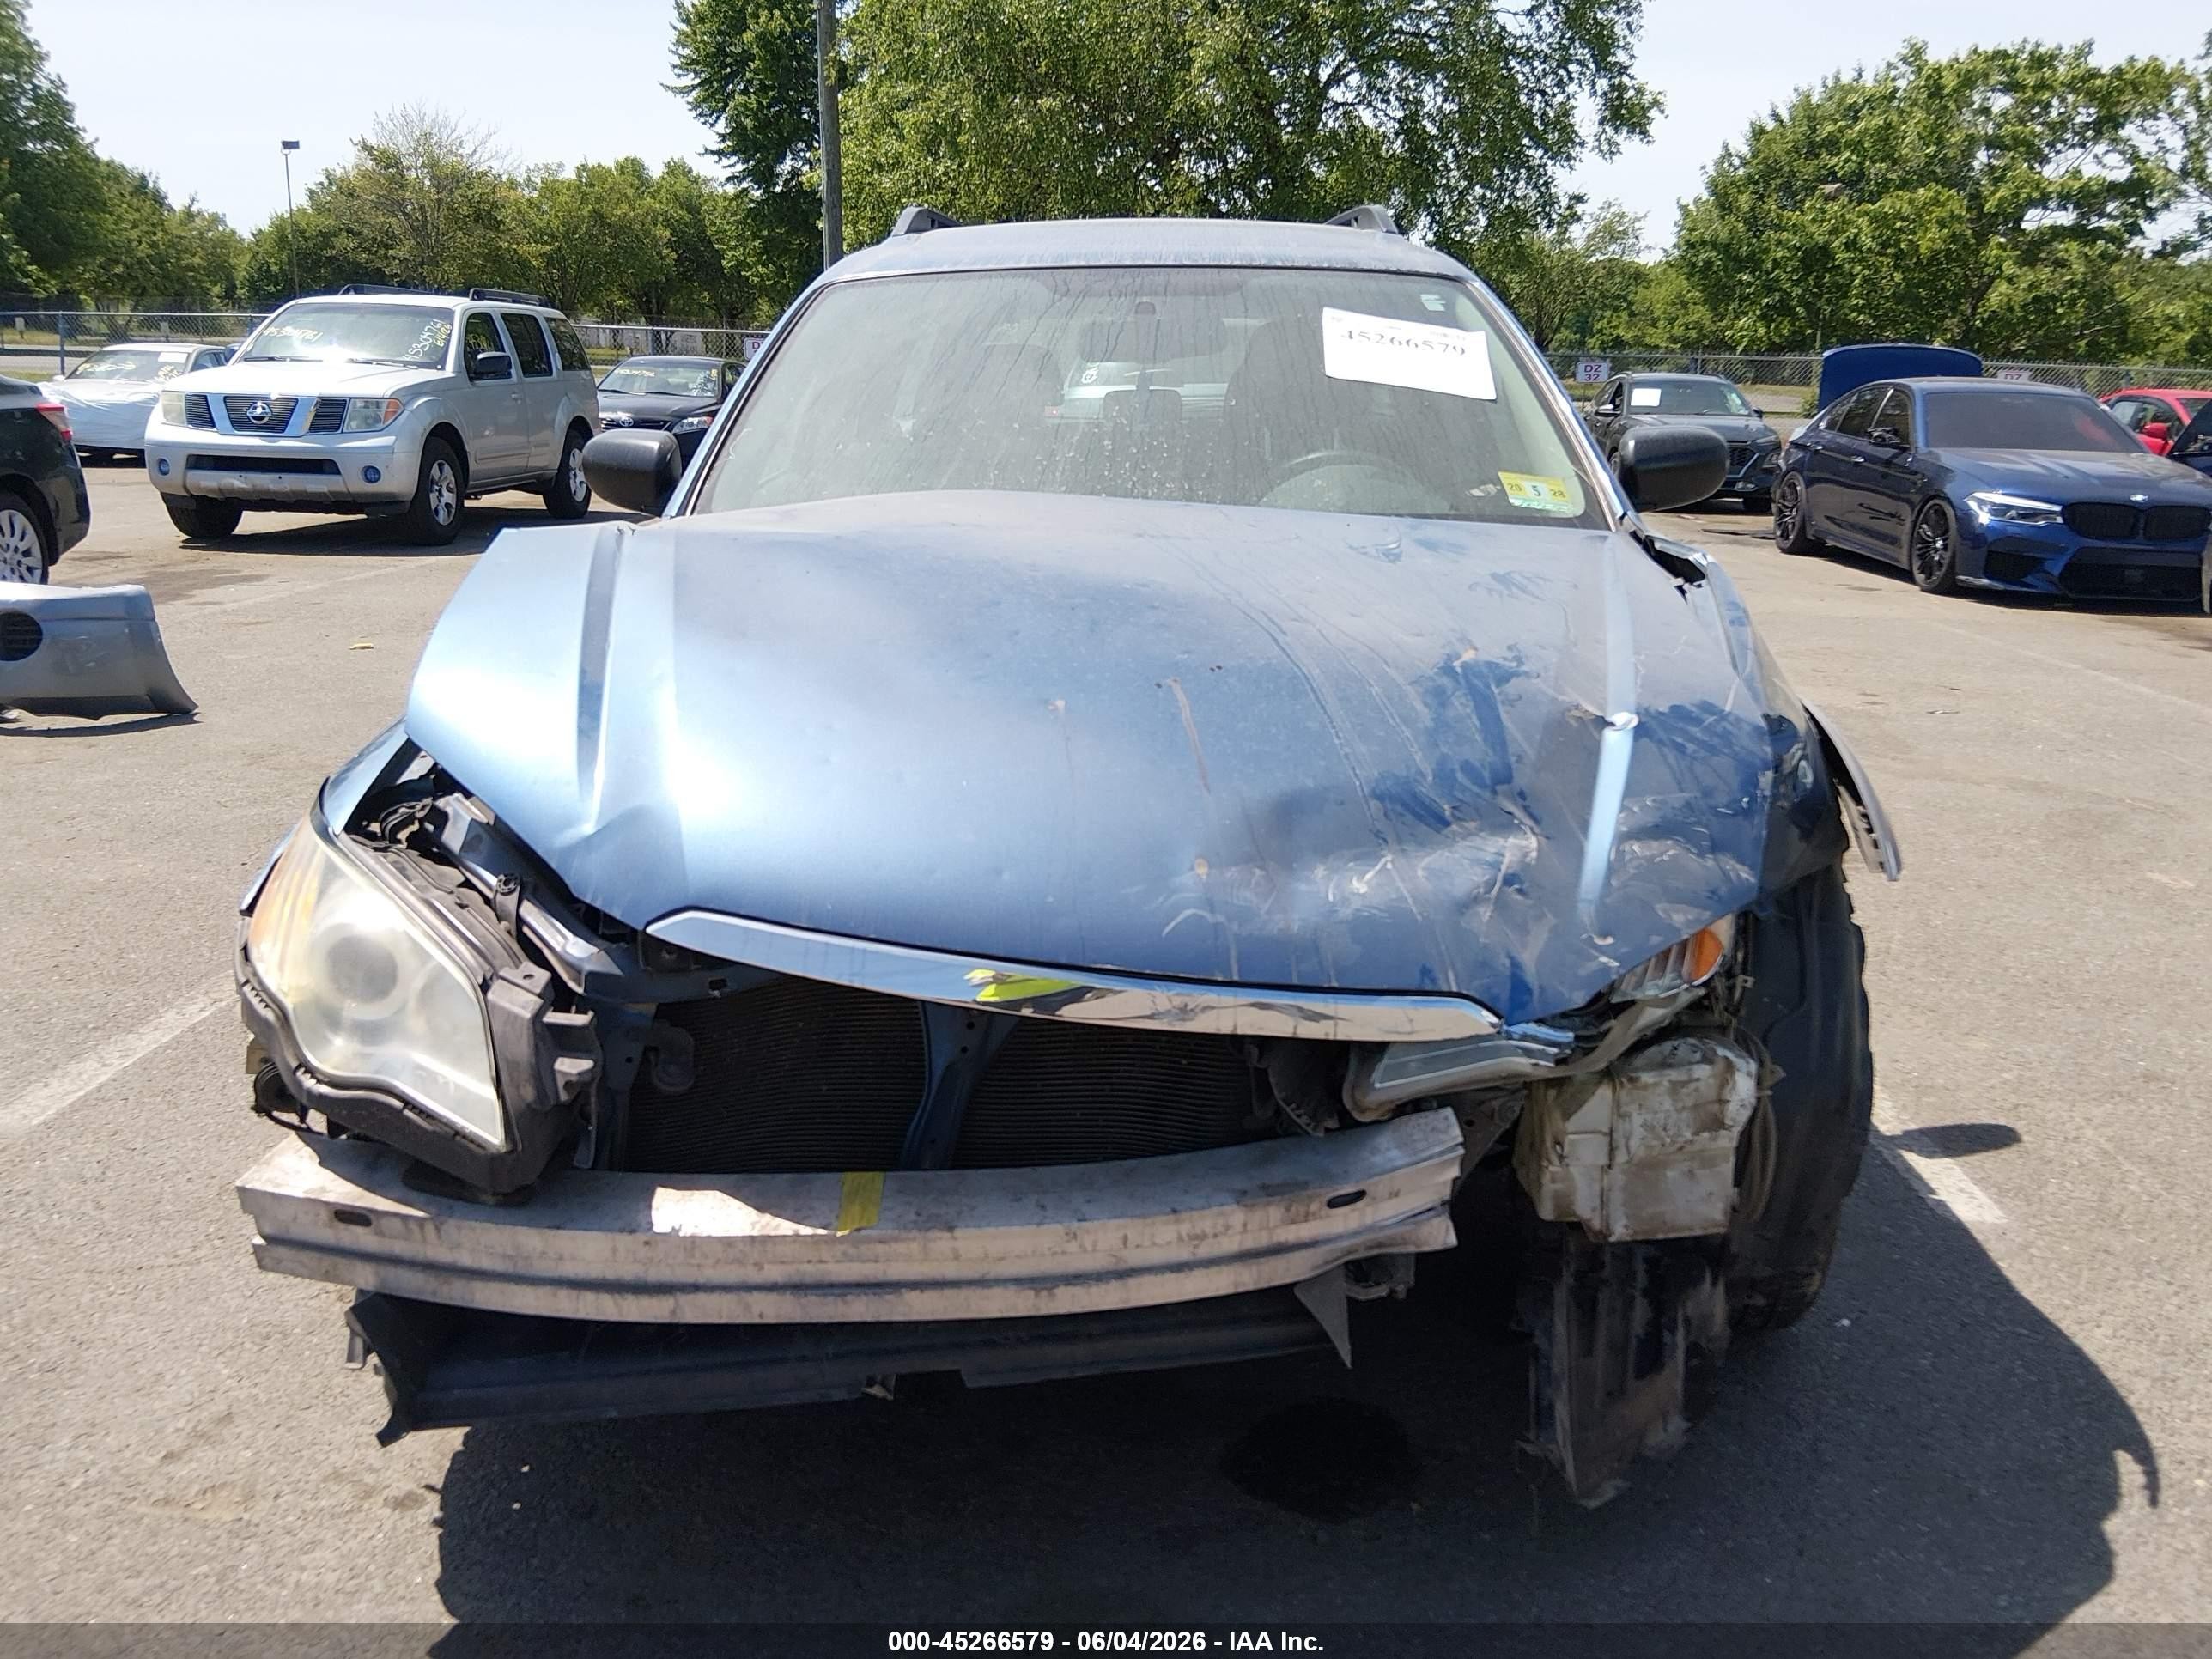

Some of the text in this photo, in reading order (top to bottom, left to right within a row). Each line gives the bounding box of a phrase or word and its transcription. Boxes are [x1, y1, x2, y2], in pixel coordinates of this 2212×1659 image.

[1584, 364, 1602, 373] DZ
[1584, 373, 1601, 381] 32
[1532, 485, 1541, 496] 5
